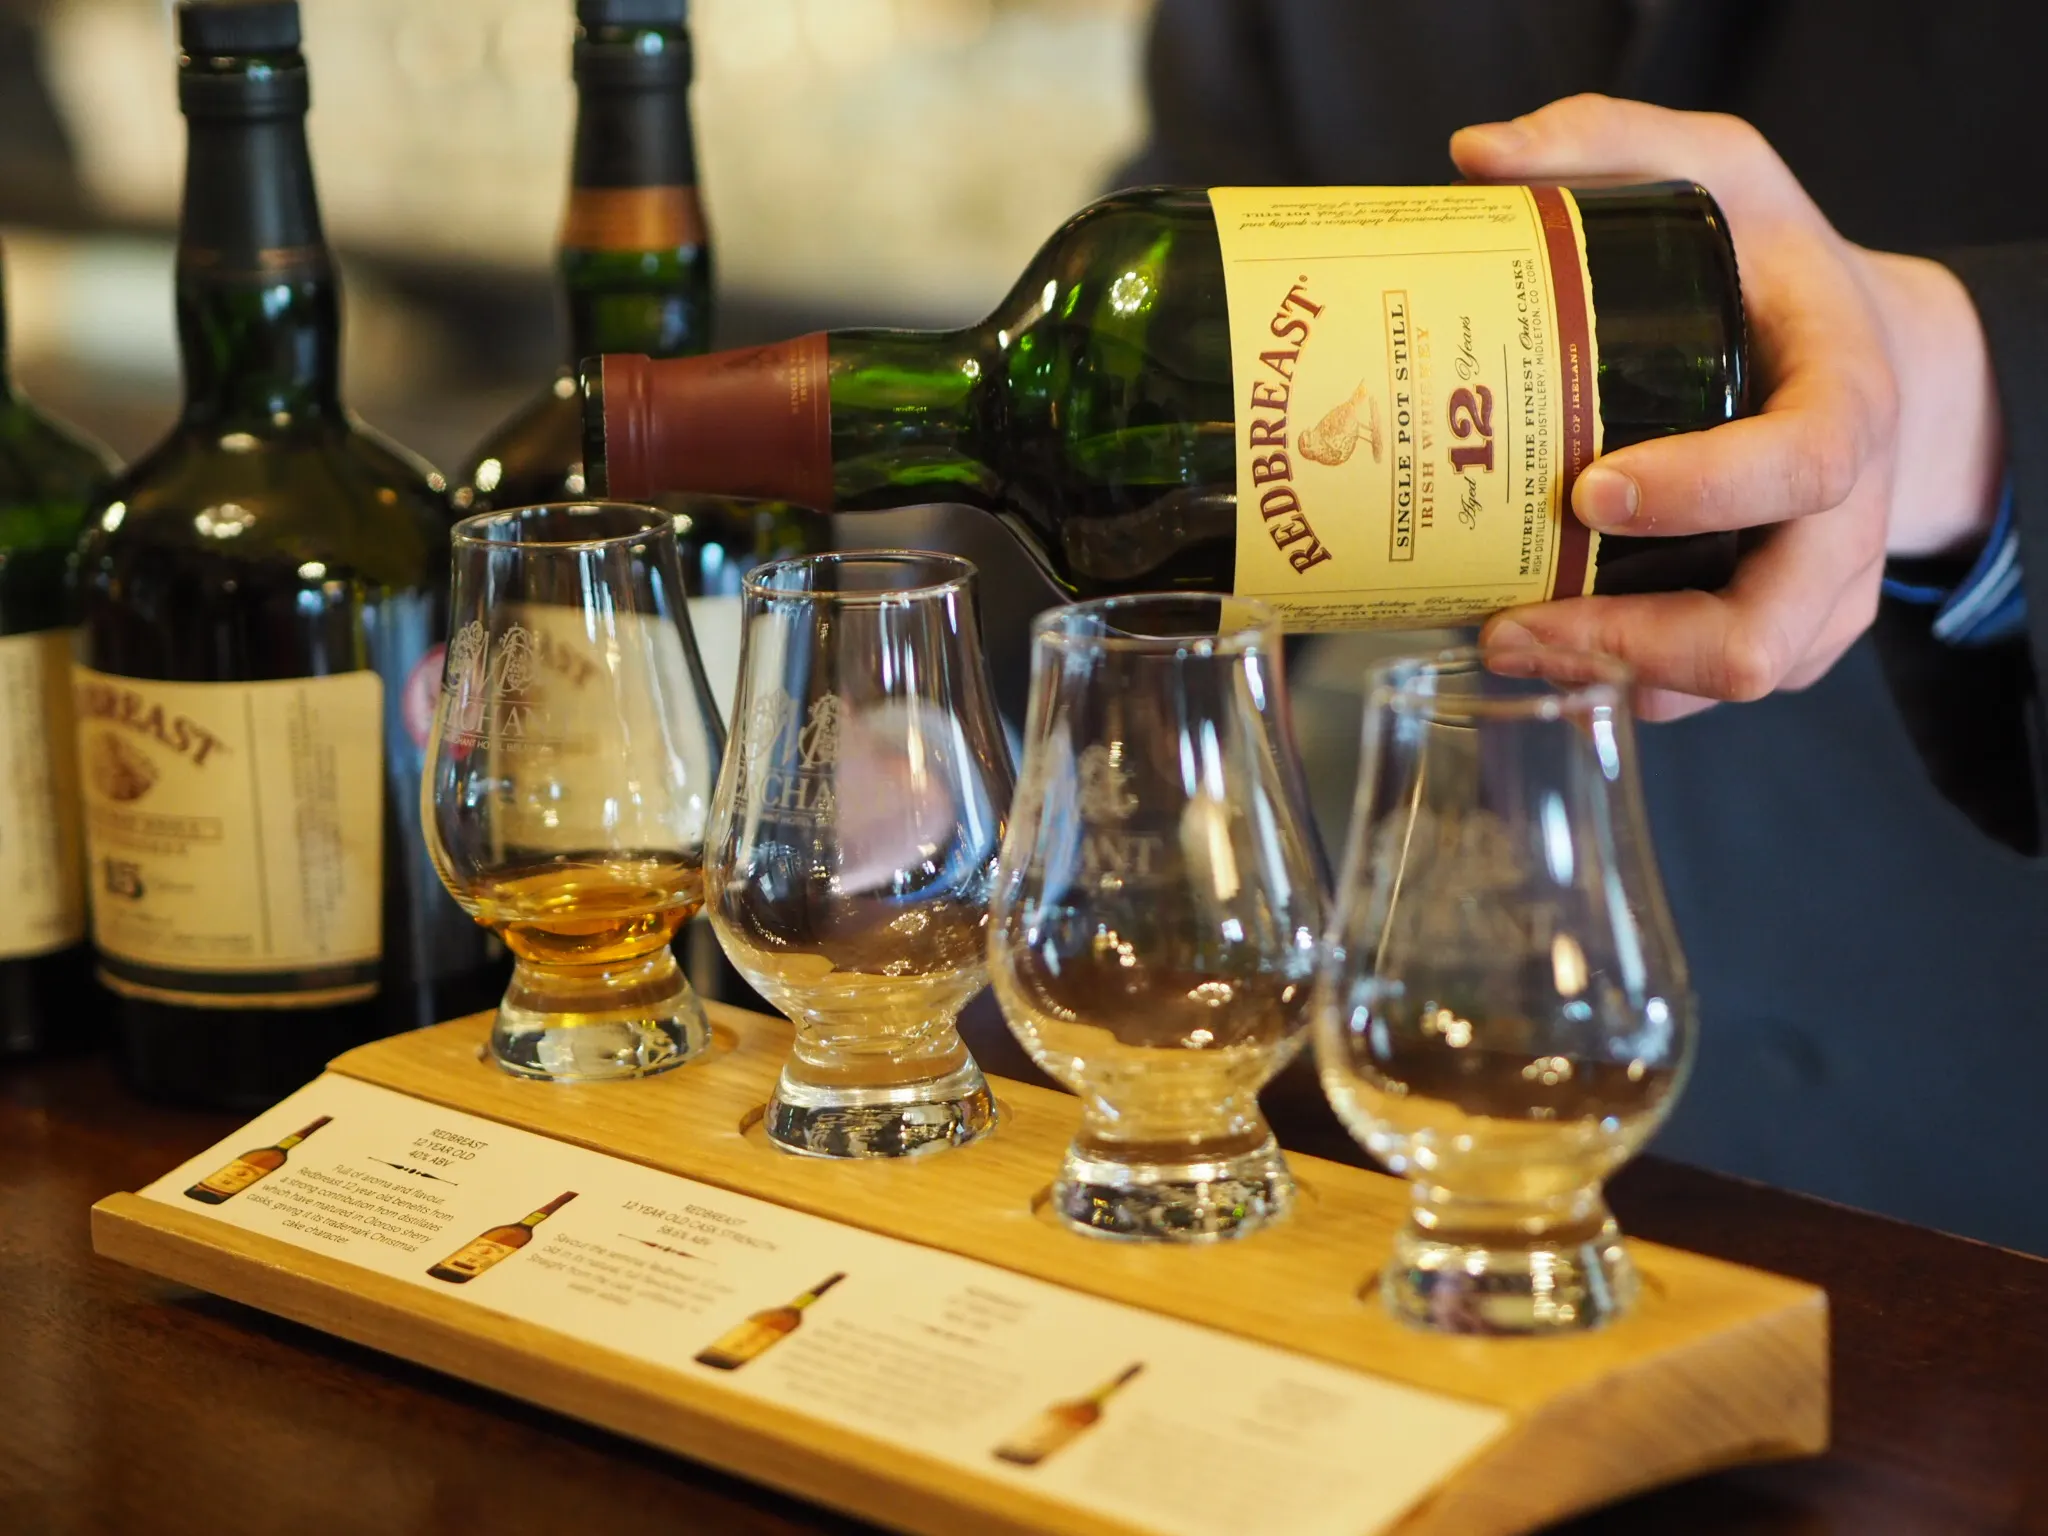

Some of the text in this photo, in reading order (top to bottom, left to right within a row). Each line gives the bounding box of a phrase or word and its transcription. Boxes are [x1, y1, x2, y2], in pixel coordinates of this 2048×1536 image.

[1525, 258, 1537, 284] CORK
[1532, 307, 1545, 366] MIDLETON,
[1537, 368, 1548, 436] DISTILLERY,
[1569, 342, 1580, 409] IRELAND
[1391, 303, 1411, 548] SINGLE POT STILL
[1416, 326, 1434, 529] IRISH WHISKEY
[1447, 315, 1494, 531] Aged 12 Years
[1512, 259, 1536, 577] MATURED IN THE FINEST Oak CASKS
[1572, 414, 1581, 433] OF
[1537, 440, 1548, 494] MIDLETON
[1534, 499, 1548, 552] DISTILLERS,
[1532, 554, 1542, 575] IRISH
[409, 1150, 455, 1167] 40% ABV
[412, 1138, 476, 1161] 12 YEAR OLD
[431, 1129, 488, 1150] REDBREAST
[288, 1179, 320, 1194] strong
[317, 1188, 376, 1211] contribution
[375, 1205, 399, 1218] from
[397, 1213, 443, 1232] distillates
[298, 1166, 454, 1221] Redbreast 12 year old benefits from
[333, 1164, 353, 1175] Full
[350, 1171, 366, 1179] of
[361, 1175, 393, 1189] aroma
[391, 1184, 415, 1195] and
[262, 1183, 435, 1245] which have matured in Oloroso sherry
[271, 1202, 304, 1217] giving
[322, 1215, 371, 1237] trademark
[370, 1231, 420, 1253] Christmas
[281, 1219, 306, 1231] cake
[638, 1203, 668, 1219] YEAR
[664, 1212, 690, 1225] OLD
[683, 1203, 748, 1226] REDBREAST
